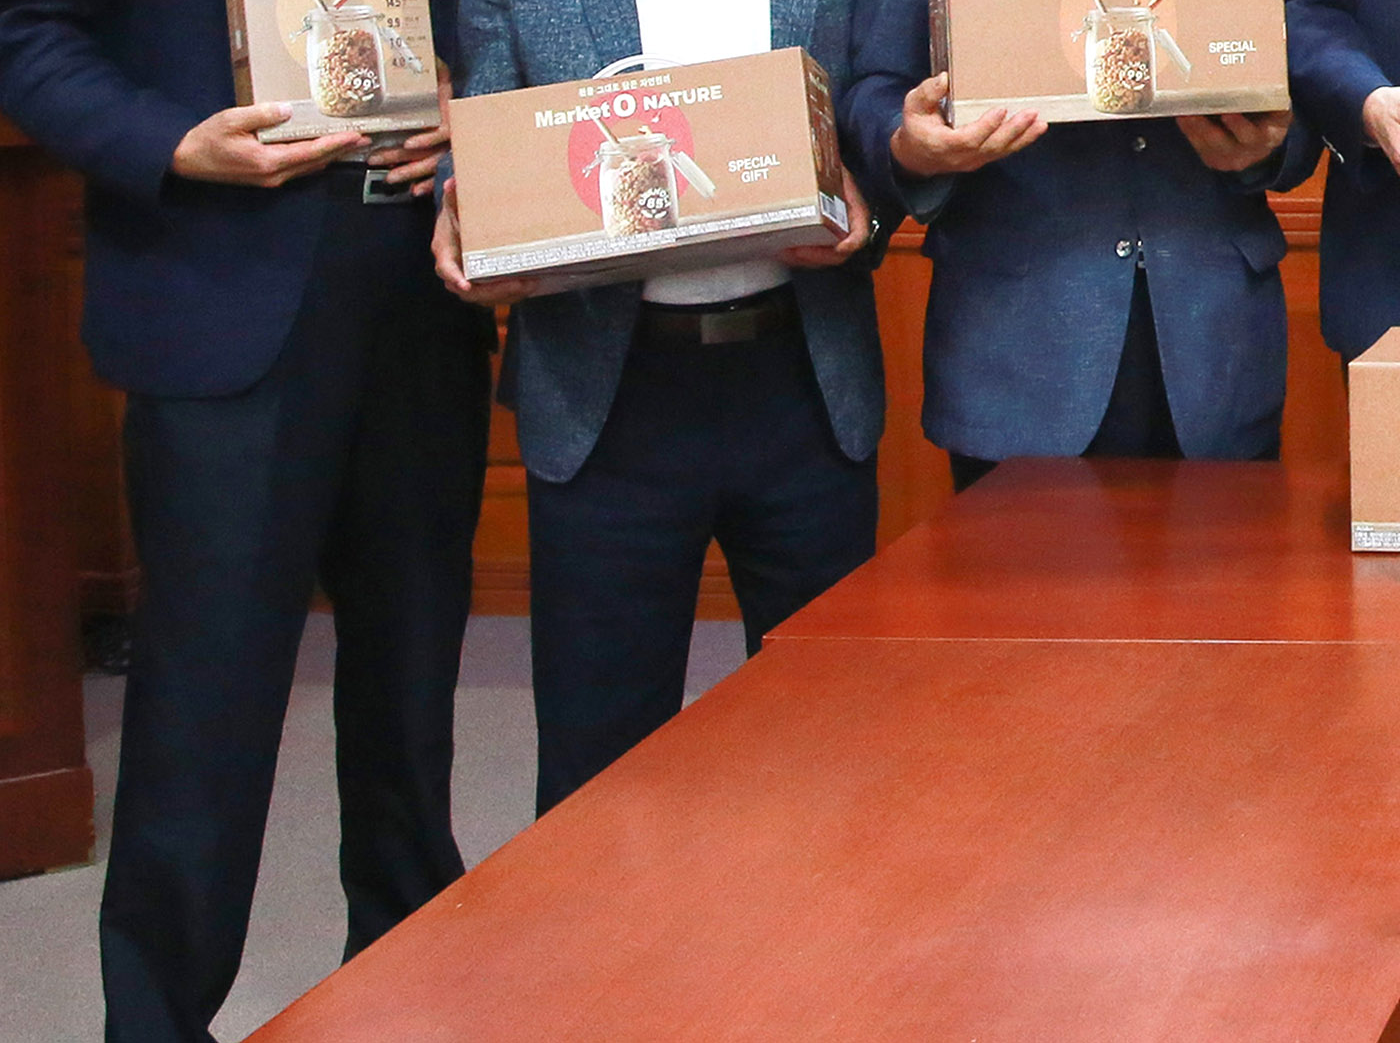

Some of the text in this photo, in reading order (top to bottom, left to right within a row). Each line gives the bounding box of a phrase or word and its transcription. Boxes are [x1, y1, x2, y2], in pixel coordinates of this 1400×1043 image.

[1209, 40, 1256, 54] SPECIAL
[1220, 54, 1246, 65] GIFT
[535, 85, 723, 128] Market O NATURE
[728, 154, 780, 173] SPECIAL
[741, 168, 769, 183] GIFT
